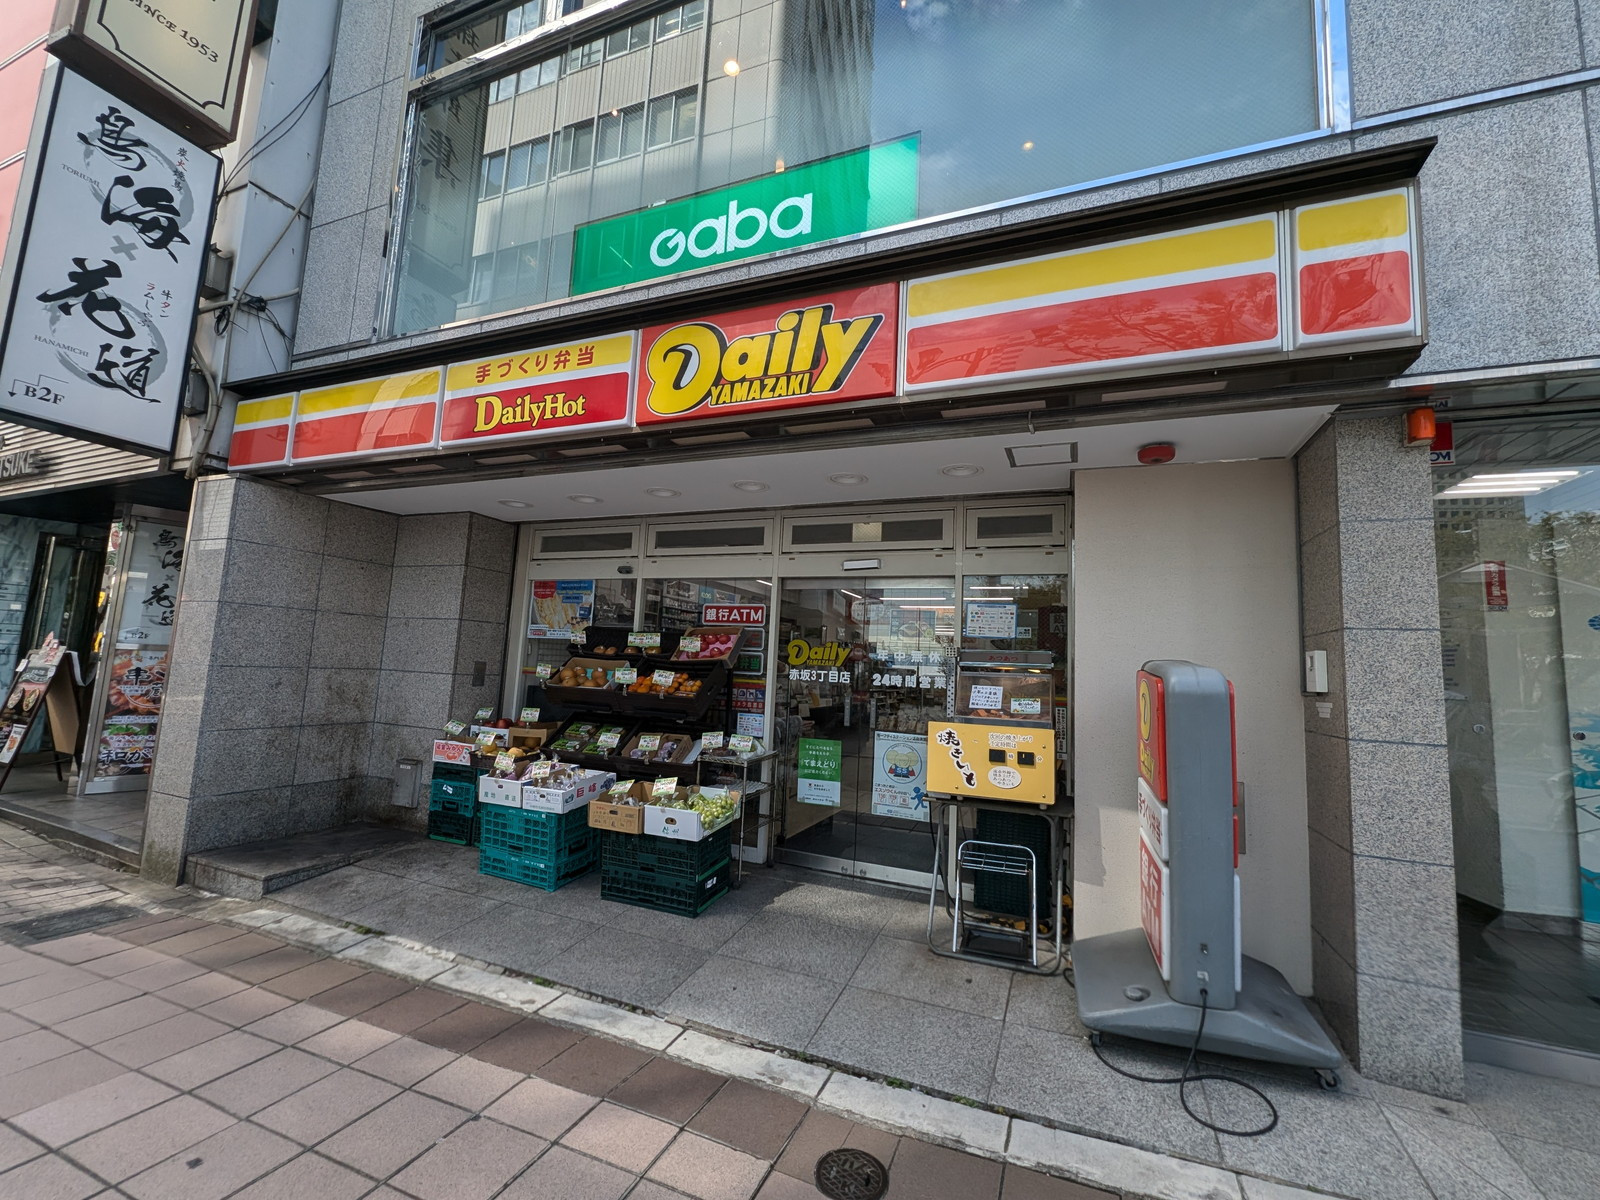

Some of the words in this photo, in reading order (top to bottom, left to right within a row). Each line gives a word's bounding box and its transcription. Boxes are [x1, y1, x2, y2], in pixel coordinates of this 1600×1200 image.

[129, 0, 178, 32] INCE
[180, 29, 219, 63] 1953
[61, 163, 100, 187] TORIUMI
[77, 105, 190, 264] 鳥海
[649, 193, 813, 268] Gaba
[160, 288, 173, 319] 牛タン
[36, 257, 161, 403] 花道
[34, 334, 90, 358] HANAMICHI
[647, 303, 885, 416] Daily
[475, 344, 596, 385] 手づくり弁当
[23, 383, 66, 405] B2F
[709, 374, 812, 406] YAMAZAKI
[473, 392, 587, 433] DailyHot
[705, 607, 763, 623] 銀行ATM
[787, 639, 852, 667] Daily
[876, 650, 942, 663] 年中無休
[788, 668, 851, 684] 赤坂3丁目店
[872, 673, 948, 689] 24時間営業
